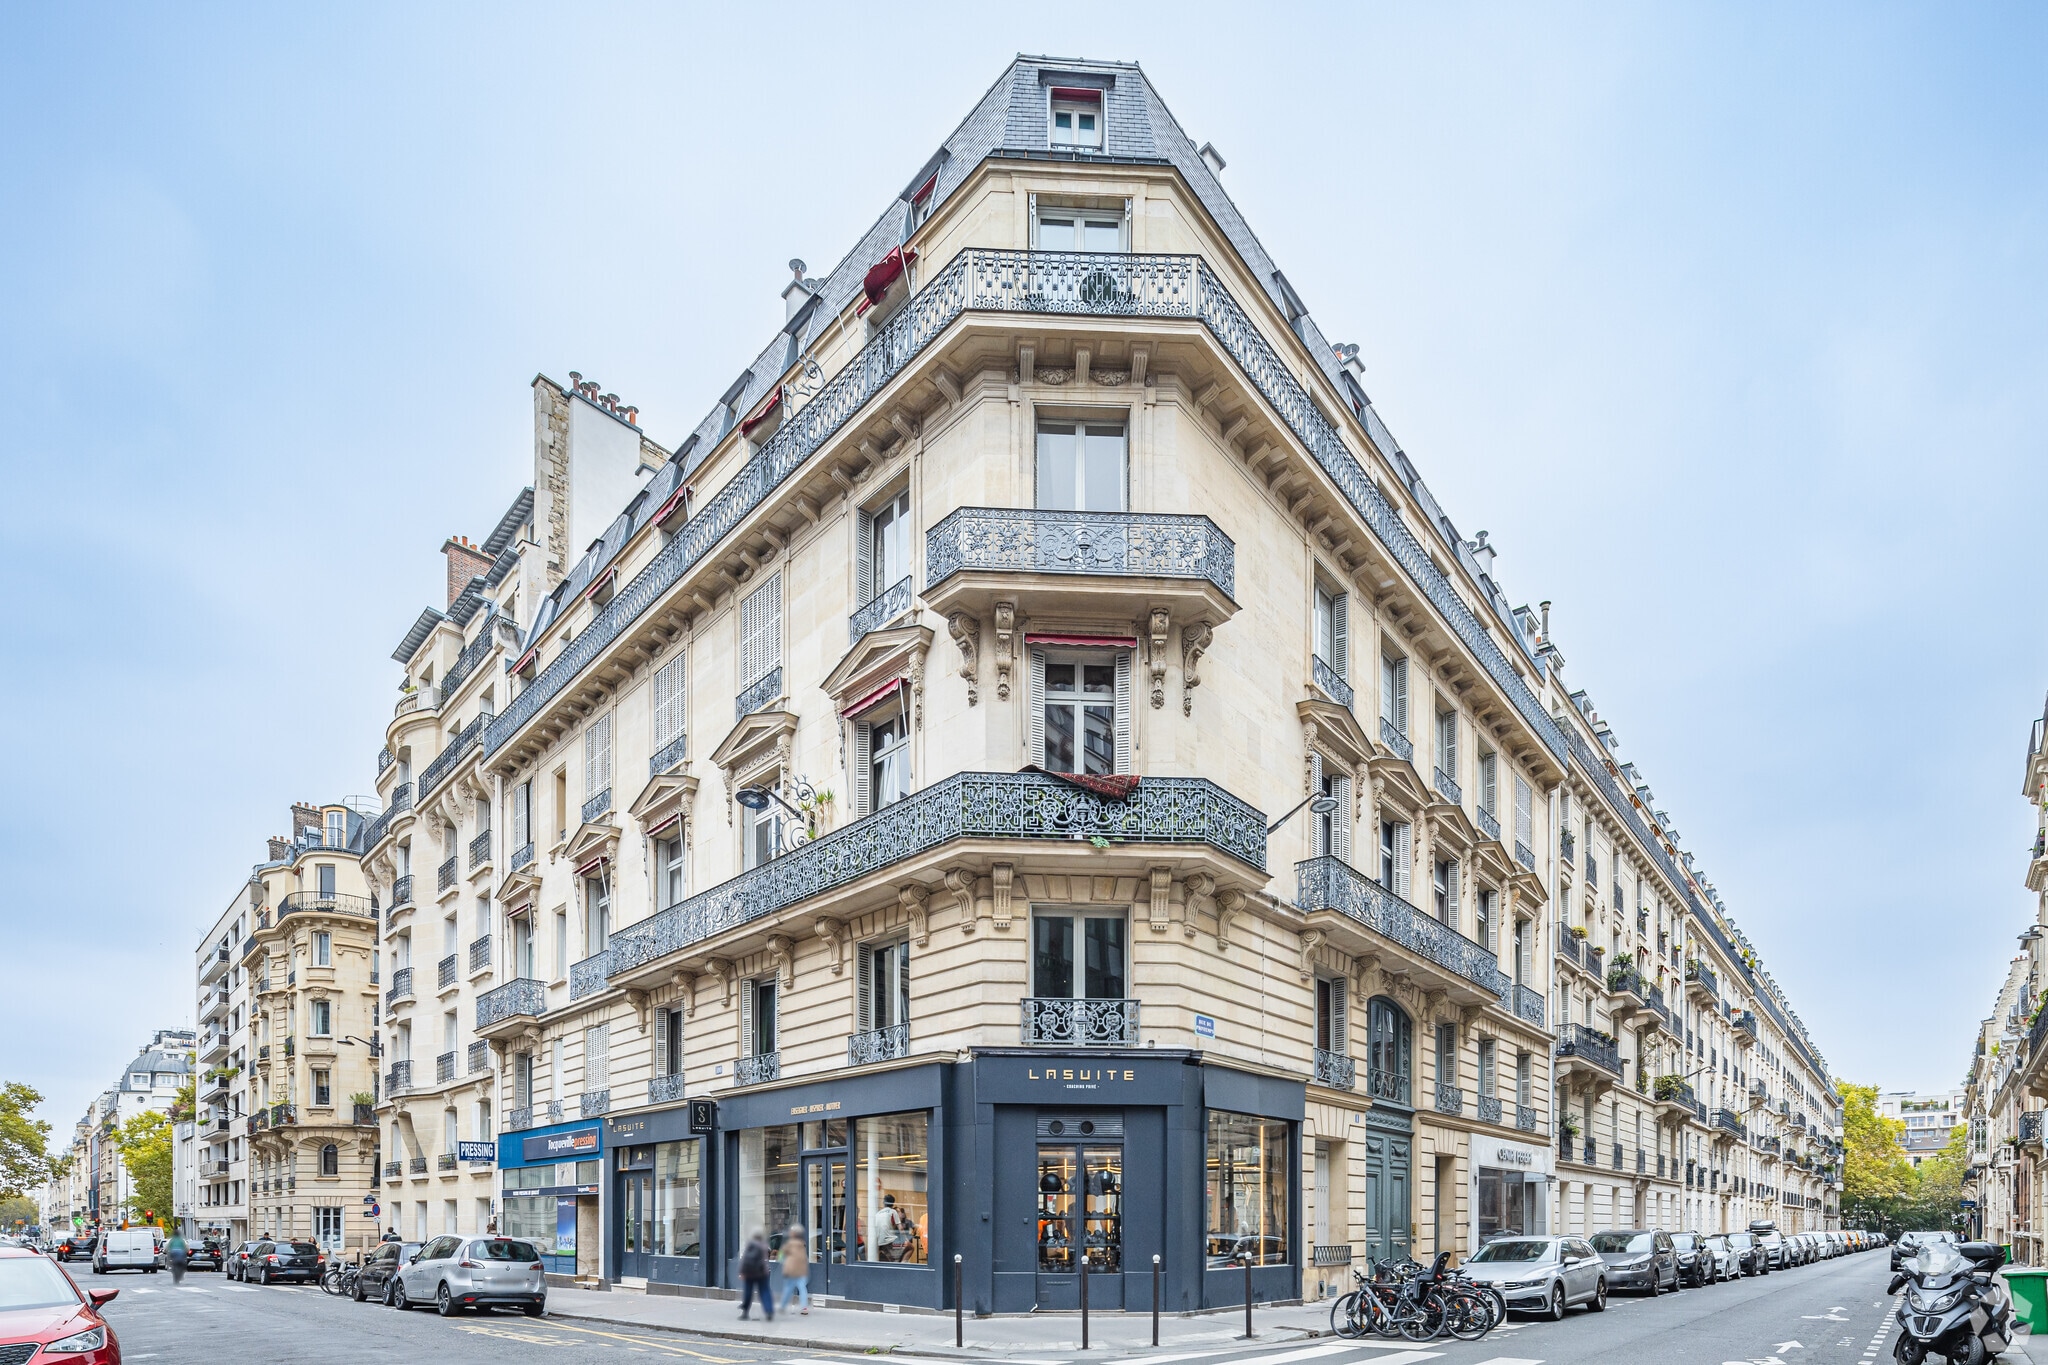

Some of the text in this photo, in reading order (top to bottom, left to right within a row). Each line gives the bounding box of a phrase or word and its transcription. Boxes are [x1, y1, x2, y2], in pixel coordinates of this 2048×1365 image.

[1028, 1068, 1135, 1081] LASUITE
[613, 1122, 645, 1133] LASUITE
[460, 1142, 494, 1157] PRESSING
